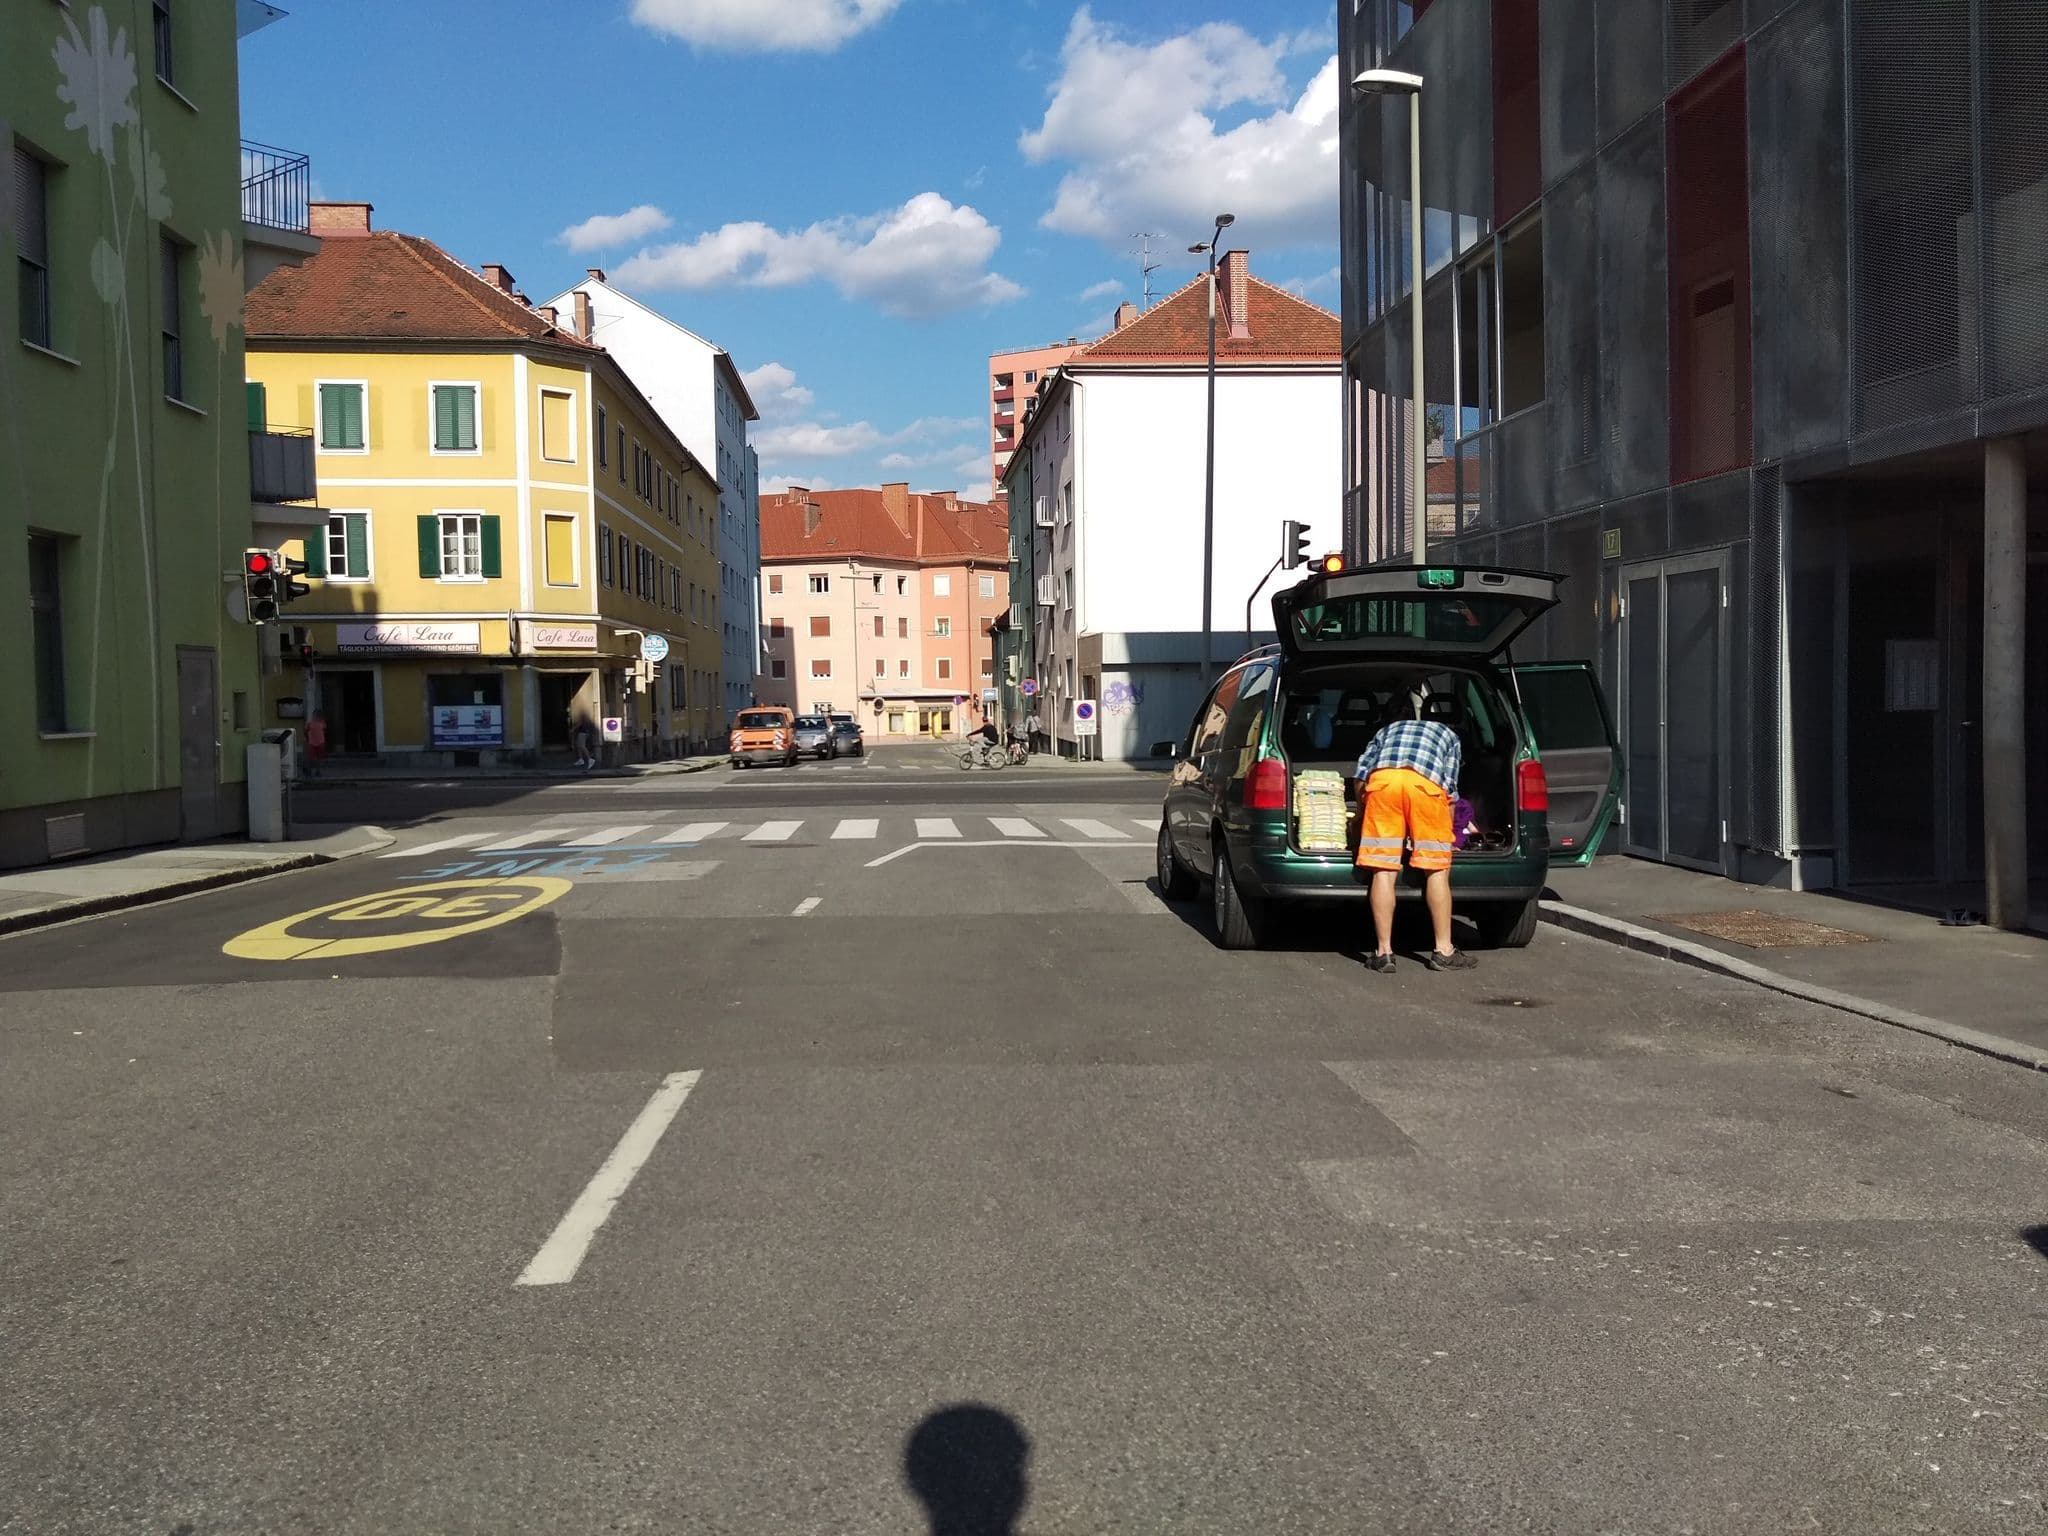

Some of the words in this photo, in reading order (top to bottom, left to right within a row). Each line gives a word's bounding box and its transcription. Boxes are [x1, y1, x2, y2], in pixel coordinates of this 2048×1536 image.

[412, 625, 454, 641] Lara
[567, 630, 594, 643] Lara
[396, 852, 672, 880] ZONE
[328, 894, 523, 921] 30
